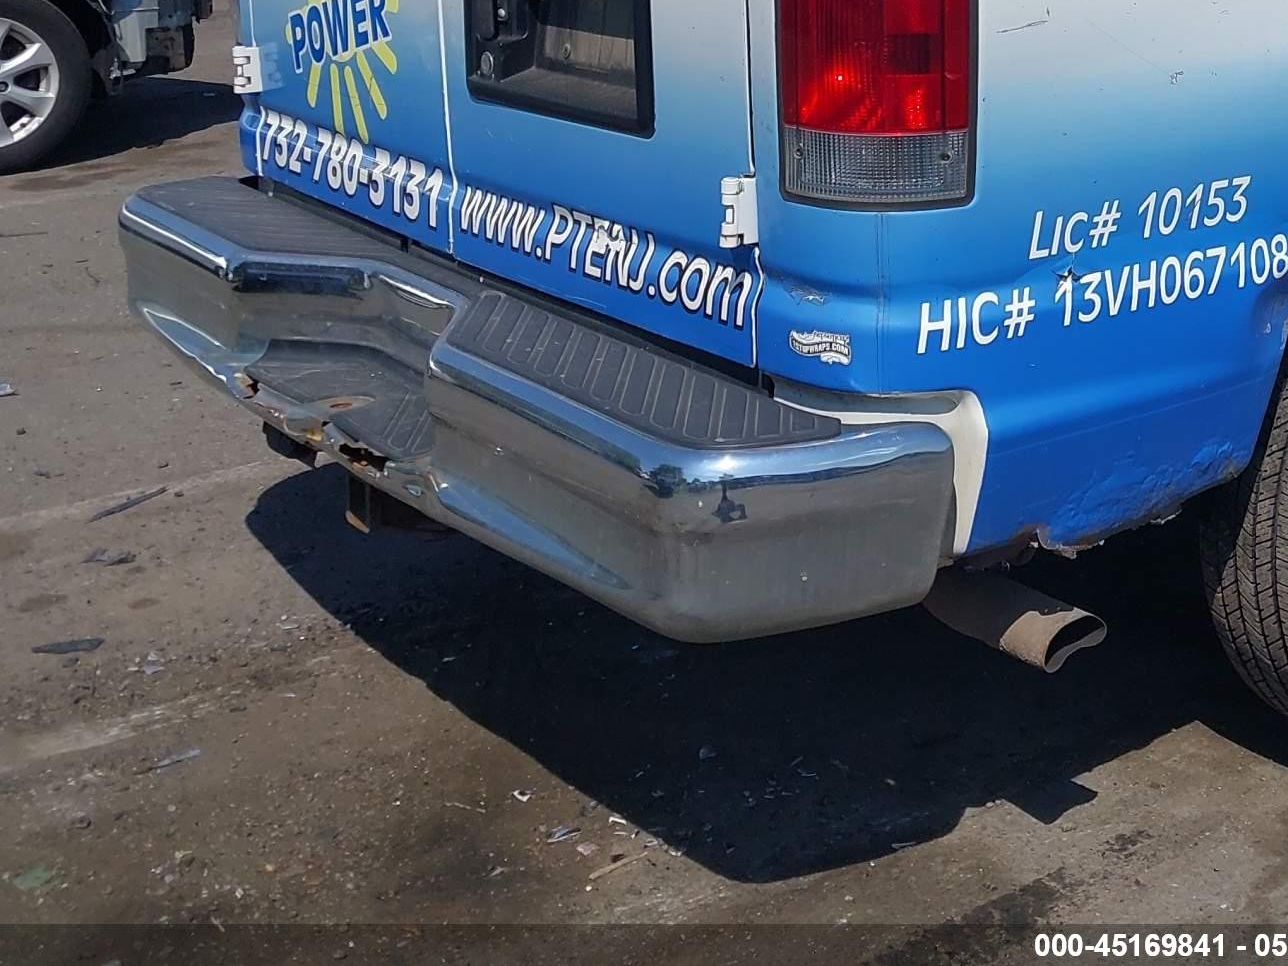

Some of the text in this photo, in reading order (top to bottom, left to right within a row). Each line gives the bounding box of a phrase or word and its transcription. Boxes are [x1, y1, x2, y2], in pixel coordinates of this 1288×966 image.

[261, 111, 443, 230] 732-780-3131
[1136, 174, 1252, 240] 10153
[916, 287, 1036, 355] HIC#
